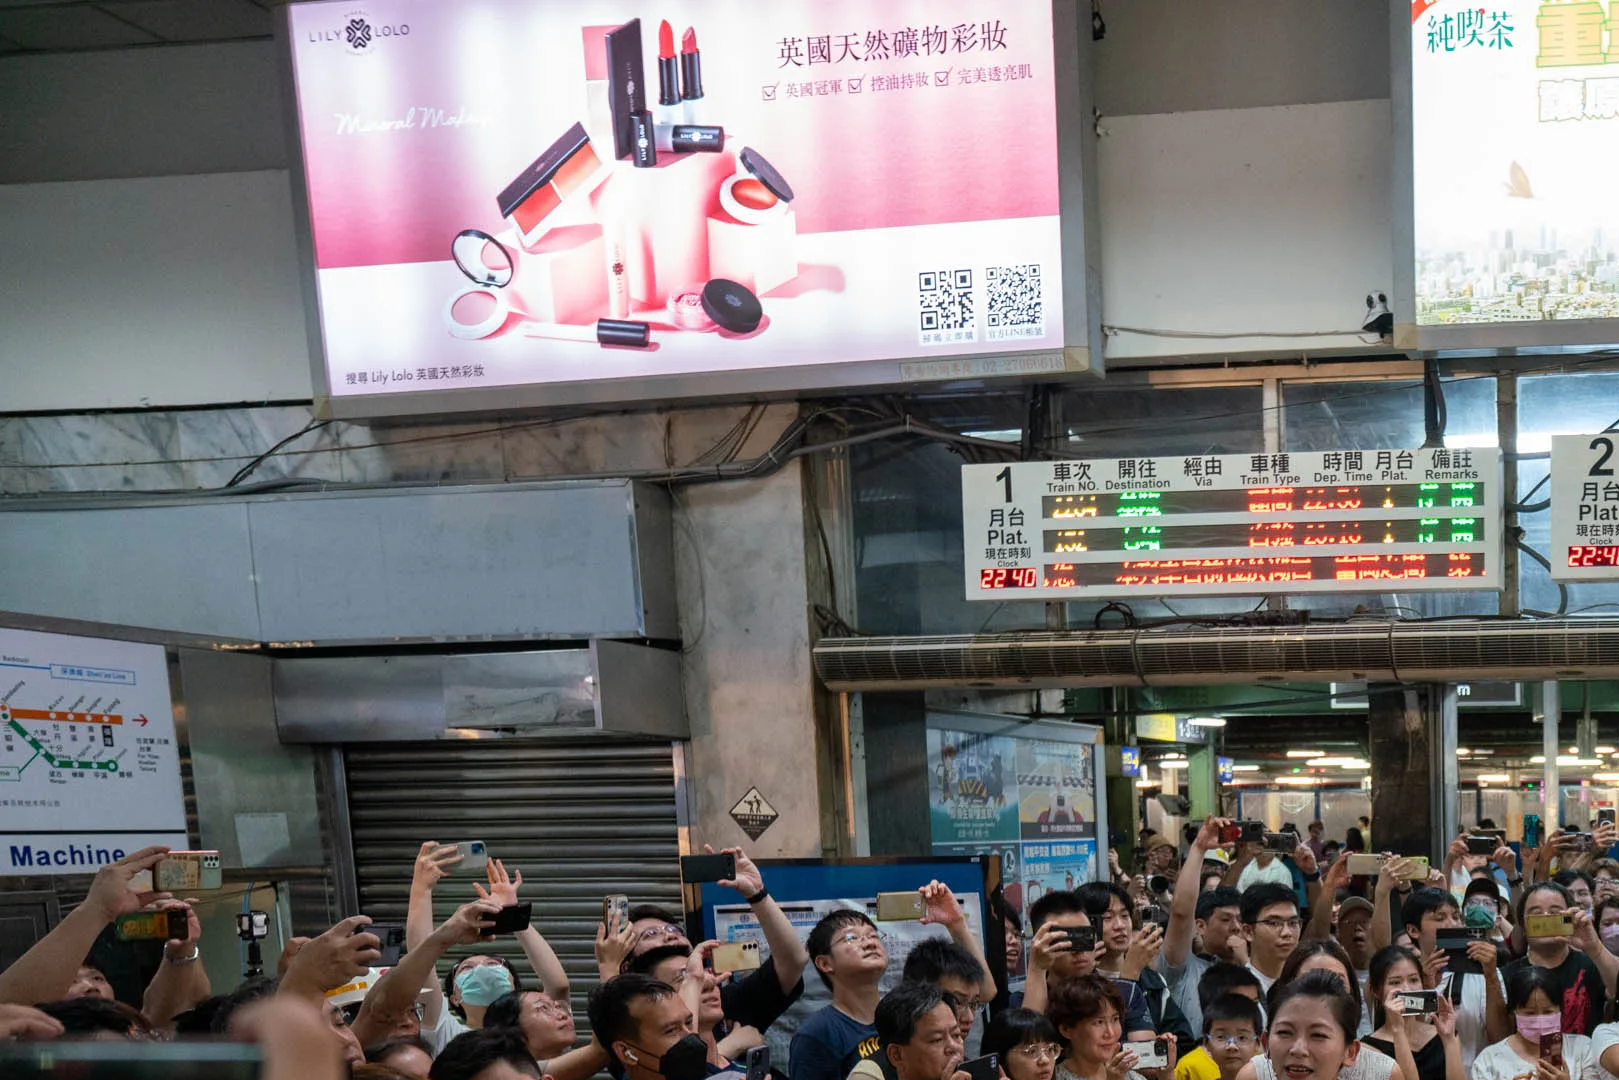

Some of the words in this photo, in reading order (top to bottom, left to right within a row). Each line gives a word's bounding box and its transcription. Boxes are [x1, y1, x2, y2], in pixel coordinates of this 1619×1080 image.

[309, 30, 342, 42] LILY
[375, 25, 410, 37] LOLO
[1427, 8, 1515, 54] 純喫茶
[776, 20, 1008, 69] 英國天然礦物彩妝
[785, 79, 843, 99] 英國冠軍
[958, 64, 1032, 85] 完美透亮肌
[346, 372, 367, 384] 搜尋
[372, 371, 388, 384] Lily
[392, 369, 413, 381] Lolo
[416, 364, 485, 380] 英國天然彩妝
[1054, 462, 1092, 480] 車次
[1118, 460, 1156, 479] 開往
[1184, 458, 1222, 476] 經由
[1251, 454, 1290, 473] 車種
[1323, 453, 1362, 471] 時間
[1376, 451, 1413, 470] 月台
[1432, 449, 1472, 468] 備註
[1588, 437, 1614, 476] 2
[996, 466, 1012, 503] 1
[1047, 483, 1074, 492] Train
[1078, 481, 1100, 491] NO.
[1106, 479, 1170, 490] Destination
[1195, 477, 1212, 487] Via
[1241, 475, 1270, 485] Train
[1273, 474, 1300, 485] Type
[1314, 473, 1340, 484] Dep.
[1344, 472, 1373, 481] Time
[1382, 471, 1407, 481] Plat.
[1425, 469, 1478, 479] Remarks
[989, 508, 1025, 527] 月台
[987, 530, 1027, 545] Plat.
[1589, 537, 1613, 545] Clock
[985, 548, 1031, 559] 現在時刻
[10, 844, 125, 867] Machine
